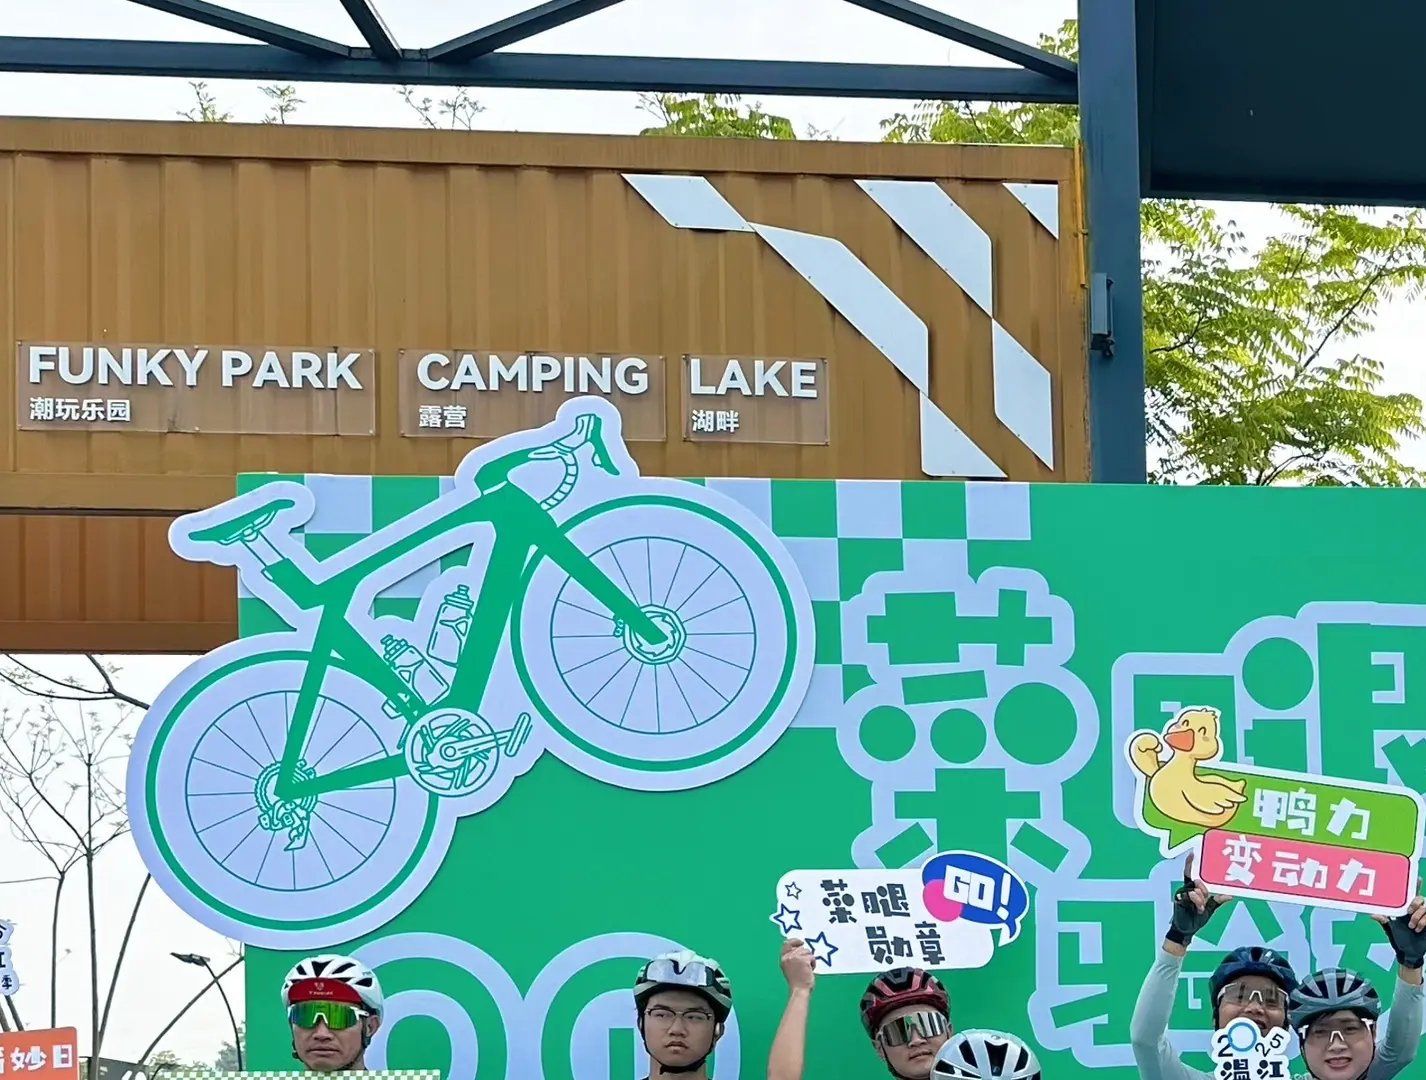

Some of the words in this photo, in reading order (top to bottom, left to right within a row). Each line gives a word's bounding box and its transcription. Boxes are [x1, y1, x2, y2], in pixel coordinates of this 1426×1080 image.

[28, 346, 209, 387] FUNKY
[220, 351, 363, 391] PARK
[416, 353, 649, 394] CAMPING
[690, 358, 818, 399] LAKE
[28, 397, 131, 423] 潮玩乐园
[418, 405, 467, 430] 露营
[691, 409, 740, 434] 湖畔
[1252, 787, 1372, 842] 鸭力
[1221, 837, 1378, 897] 变动力
[820, 878, 912, 926] 菜腿
[943, 864, 1014, 920] GO!
[868, 922, 944, 967] 勋章
[0, 1044, 73, 1076] 妙日
